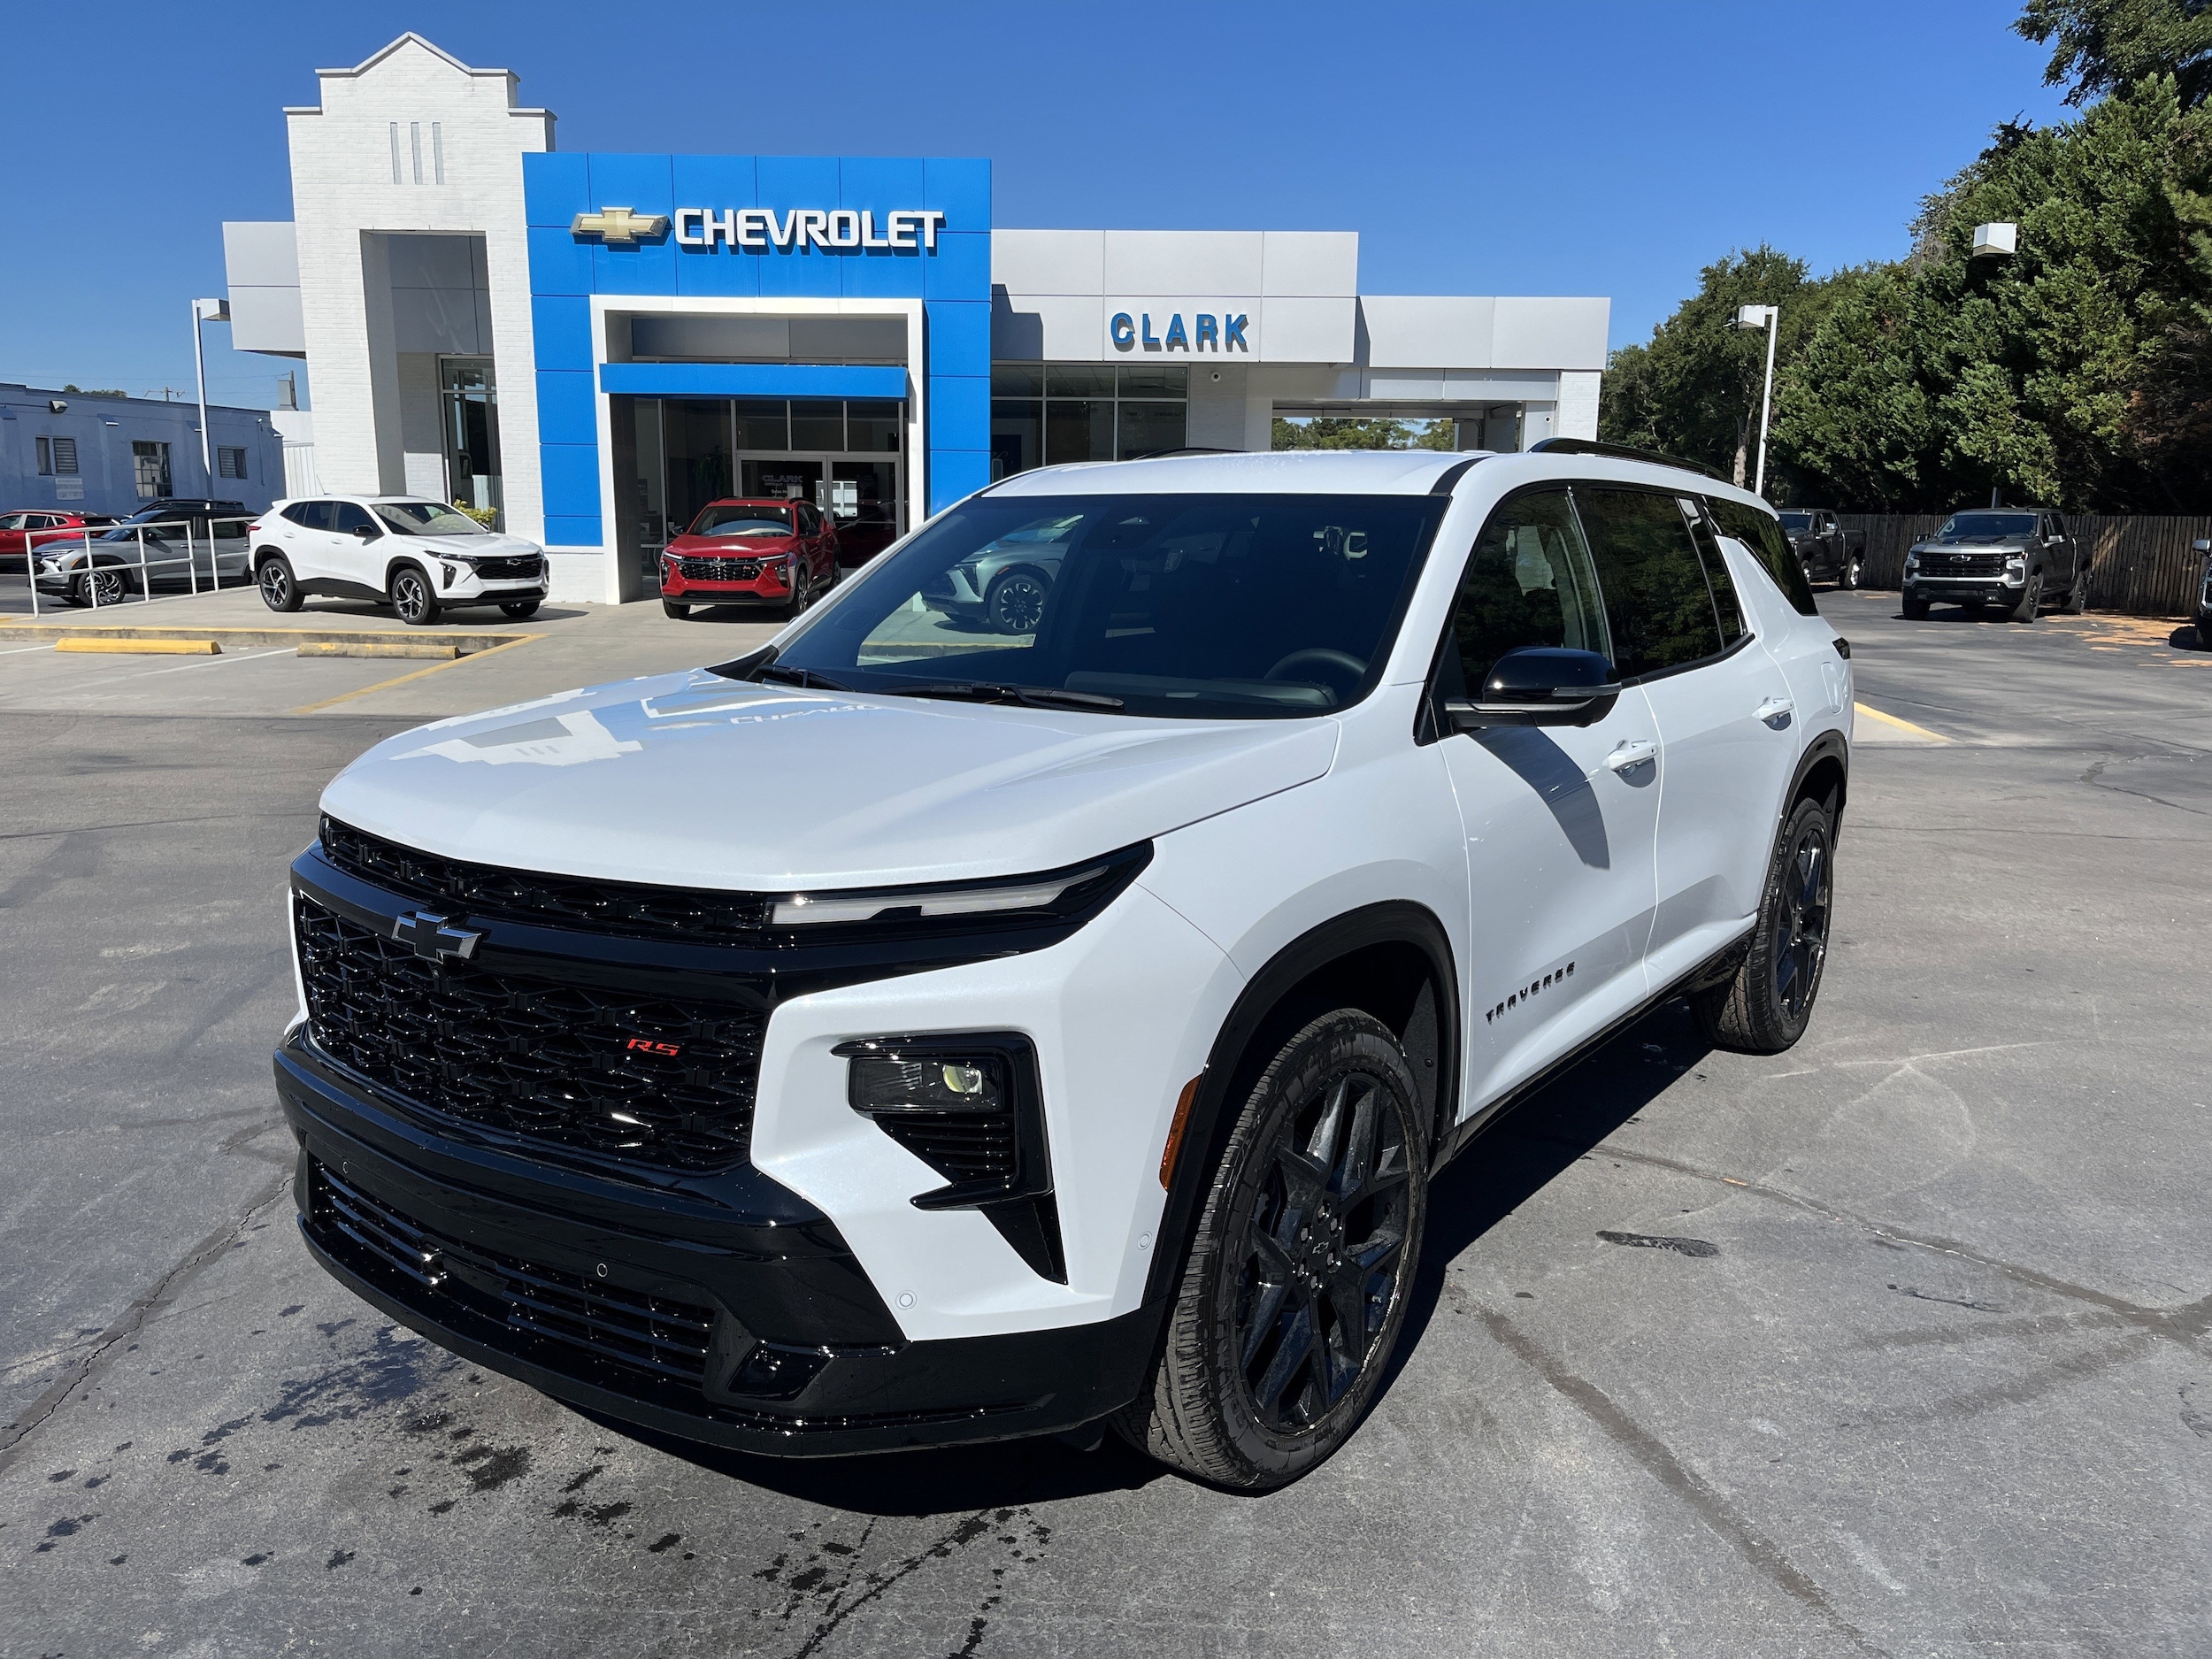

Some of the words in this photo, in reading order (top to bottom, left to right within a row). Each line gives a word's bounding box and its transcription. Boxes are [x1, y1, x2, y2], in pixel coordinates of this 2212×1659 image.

[675, 208, 943, 248] CHEVROLET
[1110, 312, 1248, 345] CLARK
[1486, 961, 1575, 1024] TRAVERSE
[626, 1038, 680, 1056] RS
